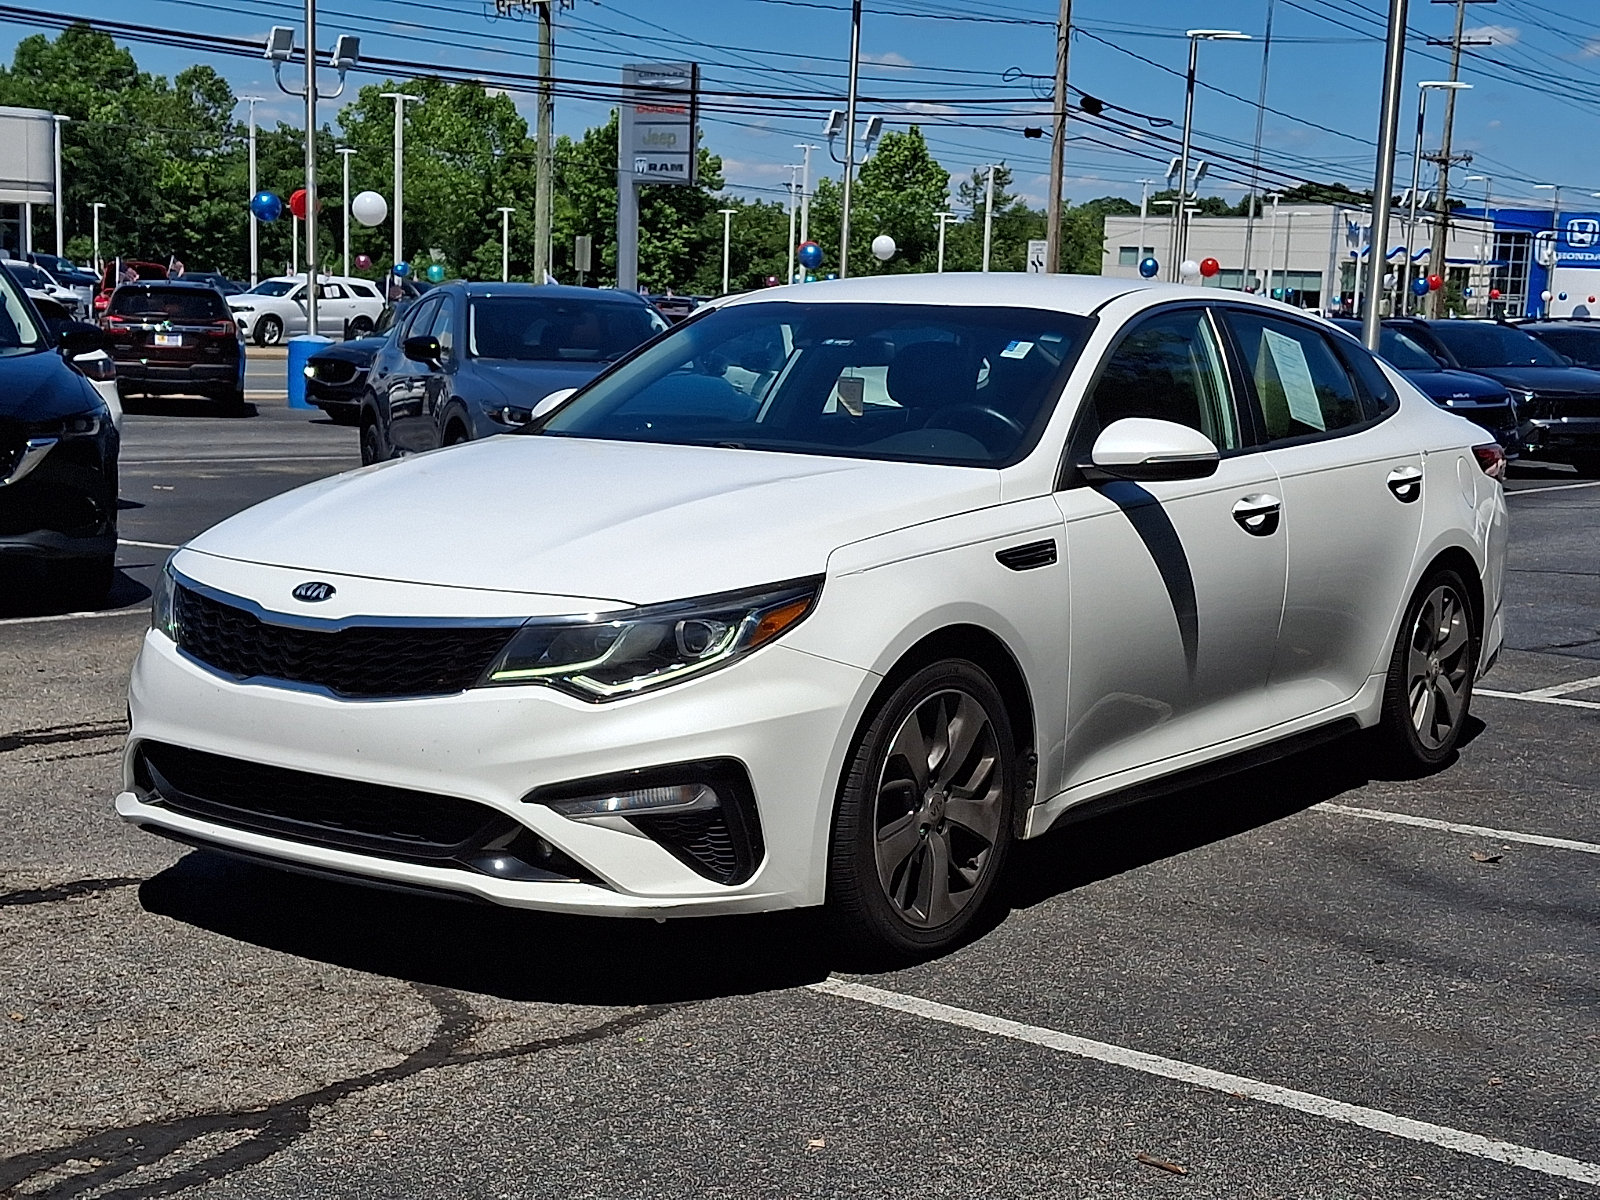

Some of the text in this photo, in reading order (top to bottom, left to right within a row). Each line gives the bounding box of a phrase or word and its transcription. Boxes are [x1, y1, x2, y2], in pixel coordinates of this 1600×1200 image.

[642, 128, 677, 148] Jeep
[648, 163, 684, 172] RAM
[295, 583, 328, 599] KIA
